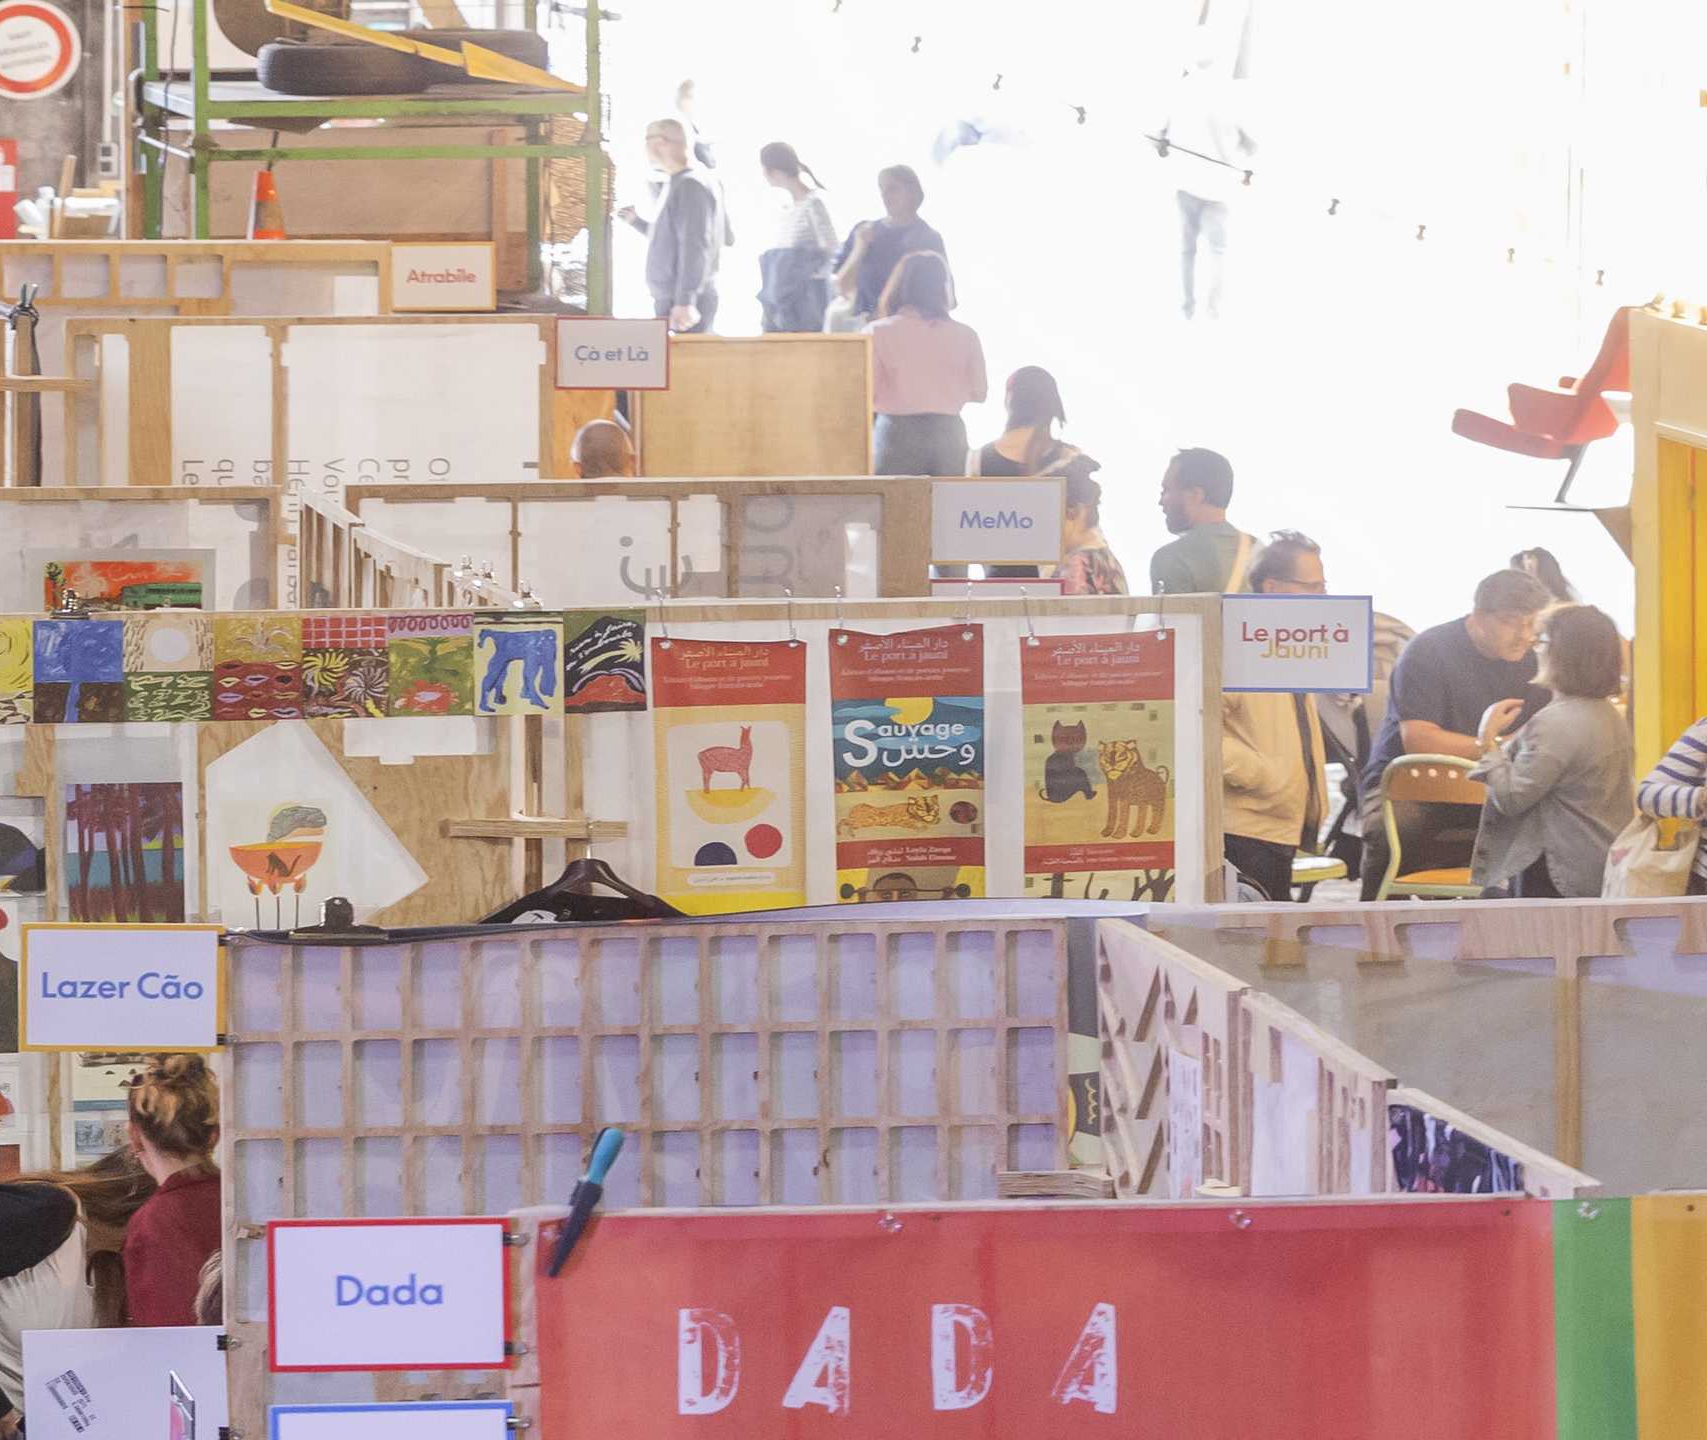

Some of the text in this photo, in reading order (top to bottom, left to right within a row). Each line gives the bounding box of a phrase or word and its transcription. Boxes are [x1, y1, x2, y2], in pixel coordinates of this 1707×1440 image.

[406, 267, 476, 285] Atrabile
[605, 347, 622, 362] et
[627, 345, 649, 362] Là
[960, 510, 1033, 529] MeMo
[1242, 621, 1350, 648] Le port à
[1261, 639, 1329, 660] Jauni
[842, 718, 965, 768] Sauvage
[40, 970, 205, 1002] Lazer Cão
[335, 1273, 445, 1307] Dada
